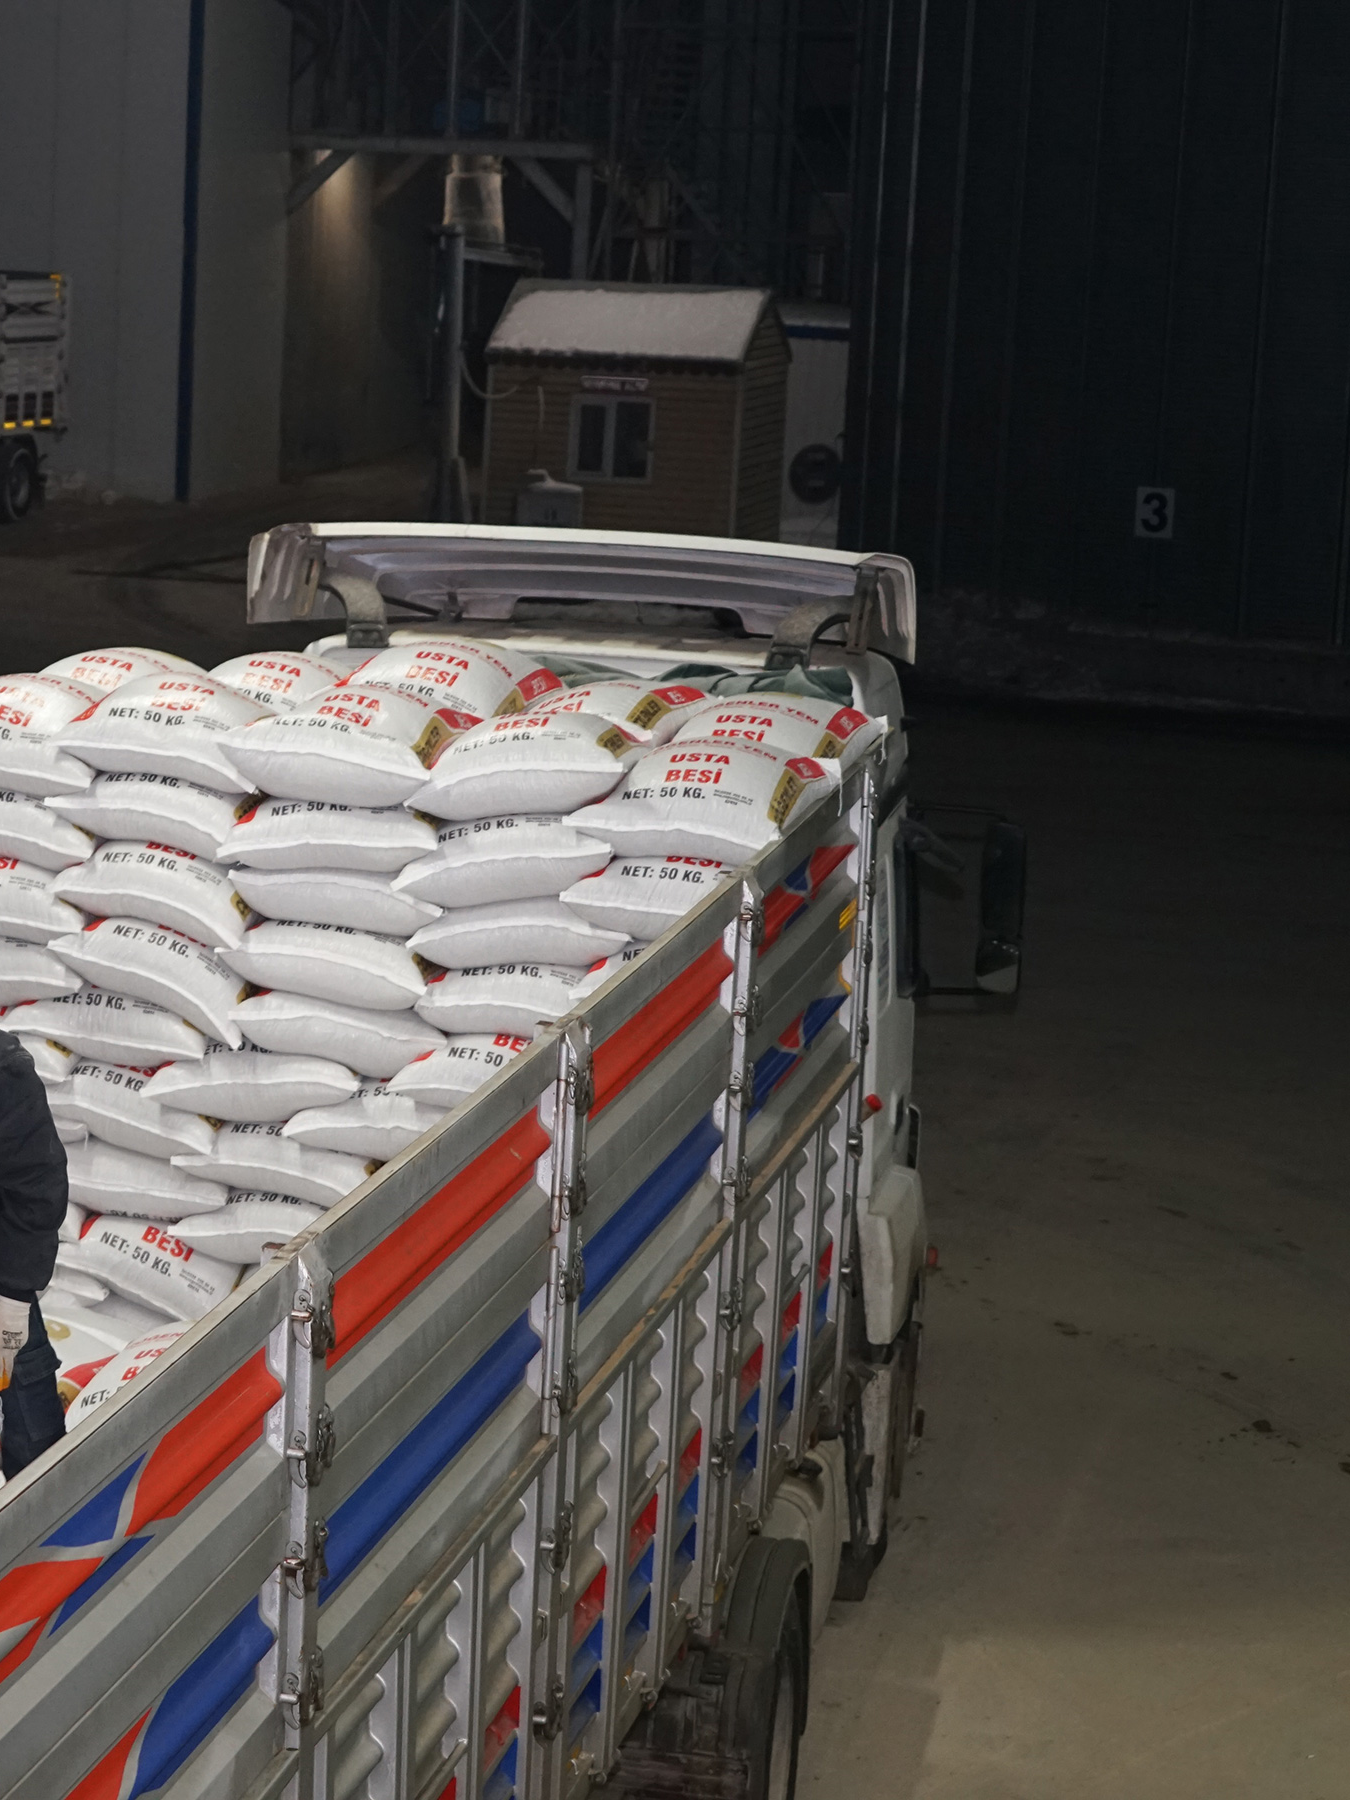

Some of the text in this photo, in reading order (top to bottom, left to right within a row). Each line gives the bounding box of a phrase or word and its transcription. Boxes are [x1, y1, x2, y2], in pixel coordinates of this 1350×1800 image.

[1141, 492, 1169, 533] 3
[81, 655, 134, 672] USTA
[248, 660, 301, 677] USTA
[415, 650, 469, 671] USTA
[159, 681, 215, 697] USTA
[254, 691, 274, 705] KG.
[324, 693, 380, 712] USTA
[108, 706, 140, 719] NET:
[144, 709, 162, 723] 50
[165, 714, 186, 727] KG.
[716, 715, 773, 728] USTA
[787, 707, 819, 725] YEM
[308, 717, 327, 728] 50
[330, 721, 352, 735] KG.
[453, 739, 484, 755] NET:
[512, 731, 535, 742] KG.
[670, 753, 731, 765] USTA
[105, 772, 181, 789] NET: 50 KG.
[664, 768, 724, 785] BESİ
[621, 786, 655, 801] NET:
[660, 787, 678, 798] 50
[682, 787, 706, 800] KG.
[271, 803, 301, 817] NET:
[306, 801, 324, 811] 50
[437, 818, 519, 844] NET: 50 KG.
[102, 852, 179, 872] NET: 50 KG.
[621, 866, 705, 884] NET: 50 KG.
[113, 924, 145, 940] NET:
[147, 932, 167, 946] 50
[169, 939, 190, 958] KG.
[461, 965, 543, 979] NET: 50 KG.
[85, 993, 102, 1006] 50
[106, 996, 126, 1011] KG.
[447, 1047, 503, 1067] NET: 50
[70, 1065, 102, 1078] NET:
[104, 1070, 123, 1085] 50
[231, 1123, 262, 1135] NET:
[226, 1192, 256, 1205] NET:
[259, 1192, 277, 1202] 50
[100, 1231, 172, 1277] NET: 50 KG.
[81, 1389, 110, 1408] NET:
